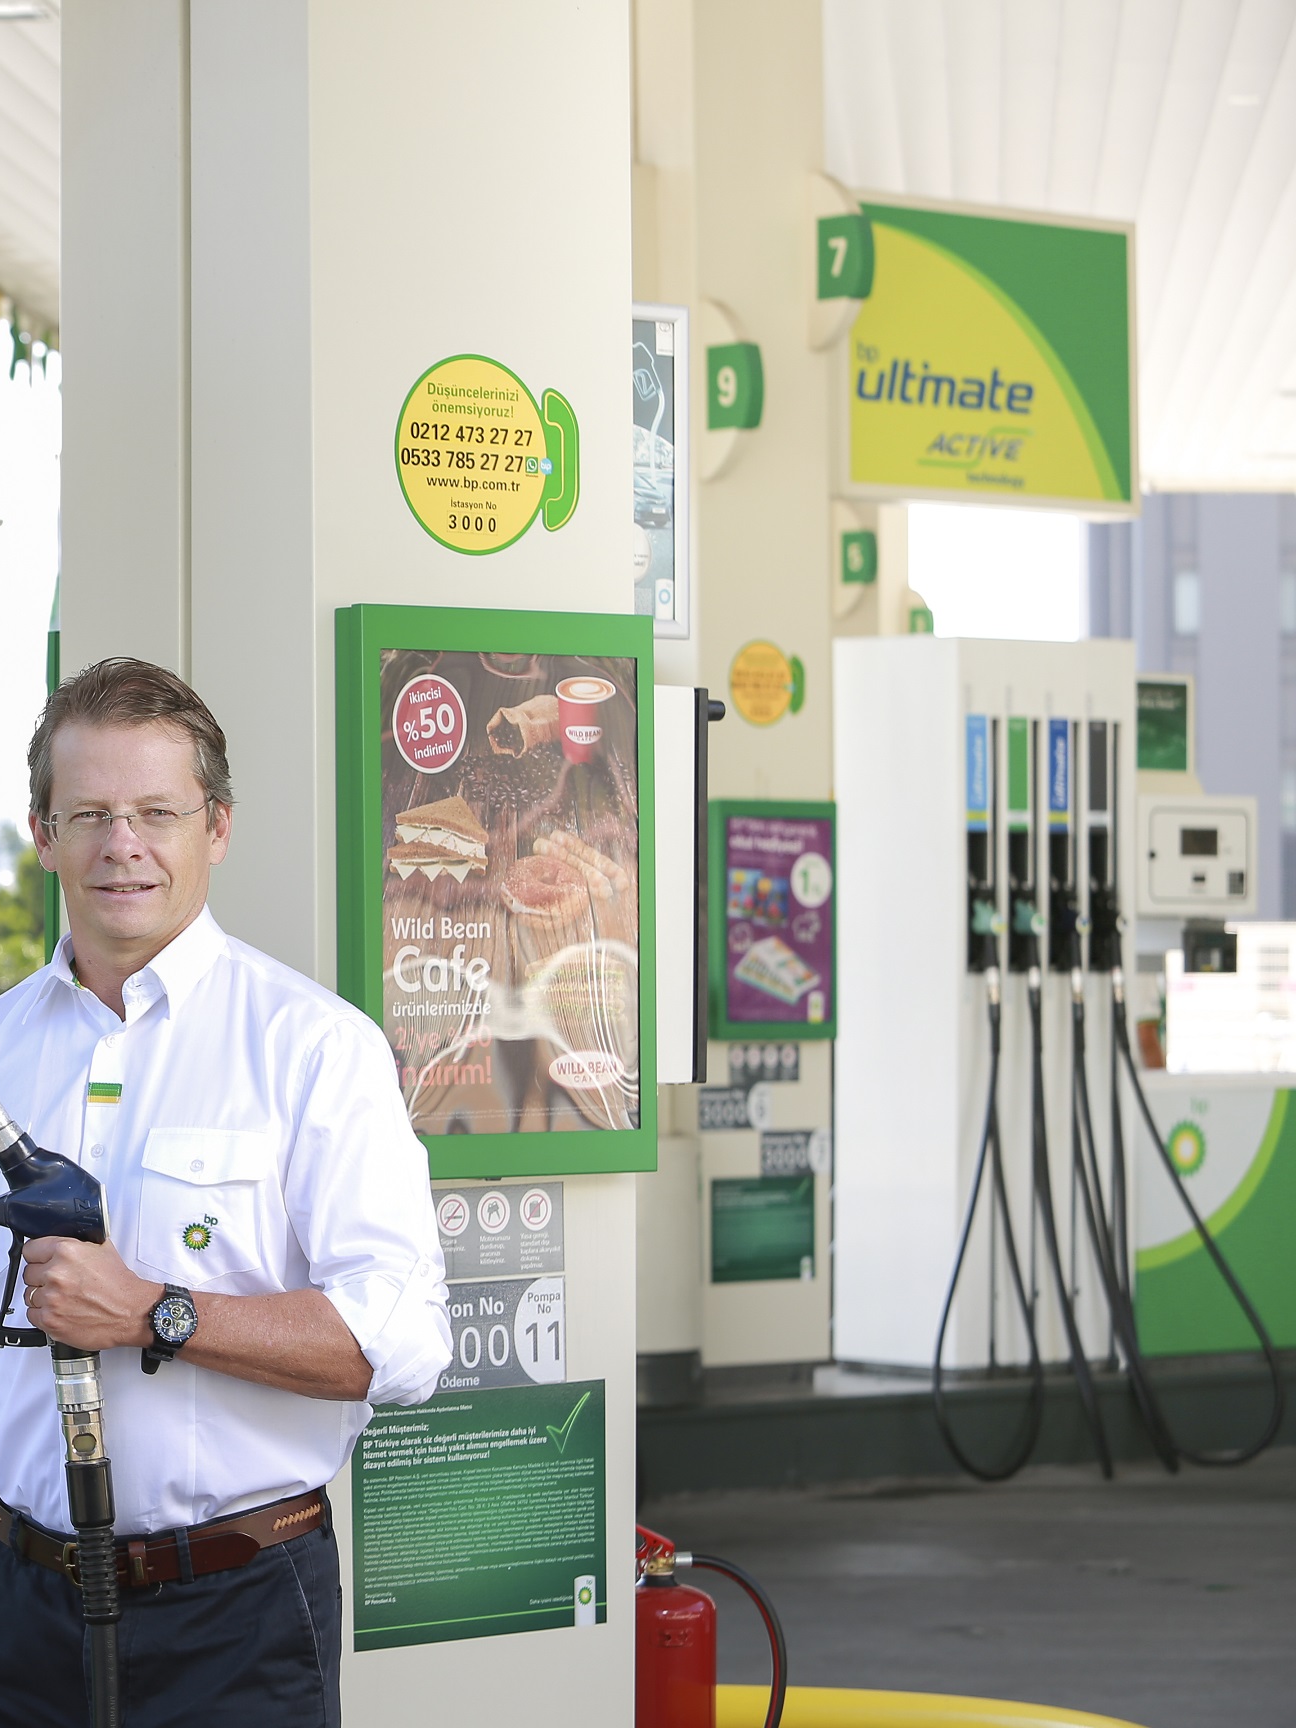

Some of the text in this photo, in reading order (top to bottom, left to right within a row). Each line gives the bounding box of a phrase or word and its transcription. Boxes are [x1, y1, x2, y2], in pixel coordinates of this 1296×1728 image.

[828, 236, 847, 278] 7
[427, 382, 519, 402] Düşüncelerinizi
[717, 366, 737, 408] 9
[857, 358, 1035, 415] ultimate
[432, 399, 514, 419] önemsiyoruz!
[410, 421, 533, 446] 0212 473 27 27
[927, 433, 1023, 462] ACTIVE
[401, 447, 441, 467] 0533
[446, 451, 475, 470] 785
[480, 453, 499, 471] 27
[505, 455, 523, 472] 27
[426, 475, 520, 492] www.bp.com.tr
[450, 497, 497, 510] İstasyon No
[408, 686, 442, 705] ikincisi
[403, 703, 455, 743] %50
[413, 740, 454, 761] indirimli
[391, 917, 491, 940] Wild Bean
[393, 944, 491, 993] Cafe
[392, 1000, 491, 1018] ürünlerimizde
[556, 1061, 618, 1076] WILD BEAN
[204, 1213, 218, 1226] bp
[480, 1296, 504, 1316] No
[527, 1292, 561, 1305] Pompa
[537, 1303, 552, 1315] No
[525, 1320, 560, 1363] 11
[440, 1373, 480, 1389] Ödeme
[362, 1426, 388, 1437] Değerli
[363, 1426, 537, 1450] BP Türkiye olarak siz değerli müşterilerimize daha iyi
[363, 1436, 548, 1460] hizmet vermek için hatalı yakıt alımını engellemek üzere
[363, 1450, 490, 1470] dizayn edilmiş bir sistem kullanıyoruz!
